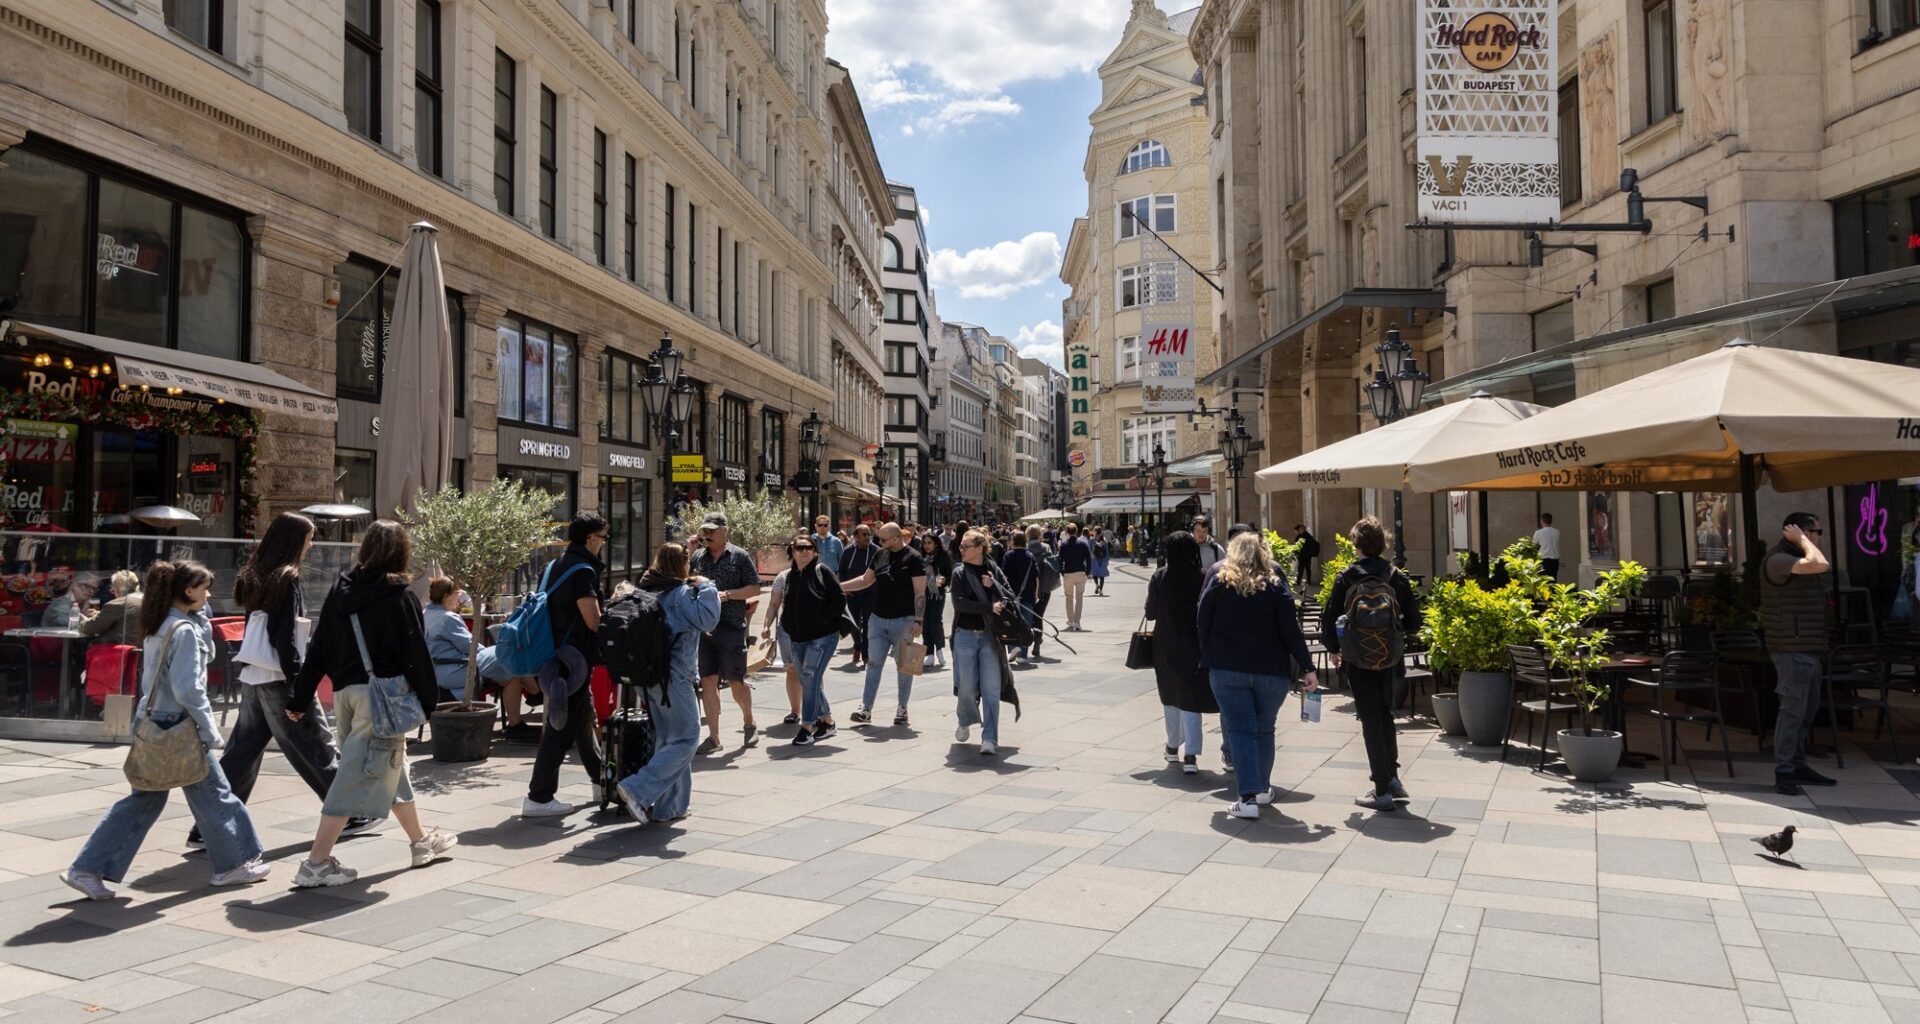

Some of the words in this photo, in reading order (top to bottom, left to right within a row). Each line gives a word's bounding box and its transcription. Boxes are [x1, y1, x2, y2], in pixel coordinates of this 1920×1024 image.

[1436, 24, 1490, 46] Hard
[1492, 24, 1541, 50] Rock
[1477, 52, 1502, 61] CAFE
[1463, 81, 1516, 90] BUDAPEST
[1431, 199, 1460, 211] VÁCI
[1463, 200, 1467, 211] 1
[1148, 328, 1189, 356] H&M
[28, 371, 78, 401] Red
[123, 365, 144, 377] WINE
[283, 398, 298, 409] PASTA
[302, 402, 316, 412] PIZZA
[1071, 353, 1089, 436] anna
[141, 391, 196, 411] Champagne
[196, 400, 214, 414] bar
[520, 438, 570, 459] SPRINGFIELD
[1496, 448, 1526, 469] Hard
[1524, 444, 1558, 467] Rock
[1554, 441, 1586, 462] Cafe
[609, 453, 645, 469] SPRINGFIELD
[1326, 468, 1341, 484] Cafe
[4, 485, 43, 510] Red
[183, 493, 212, 513] Red
